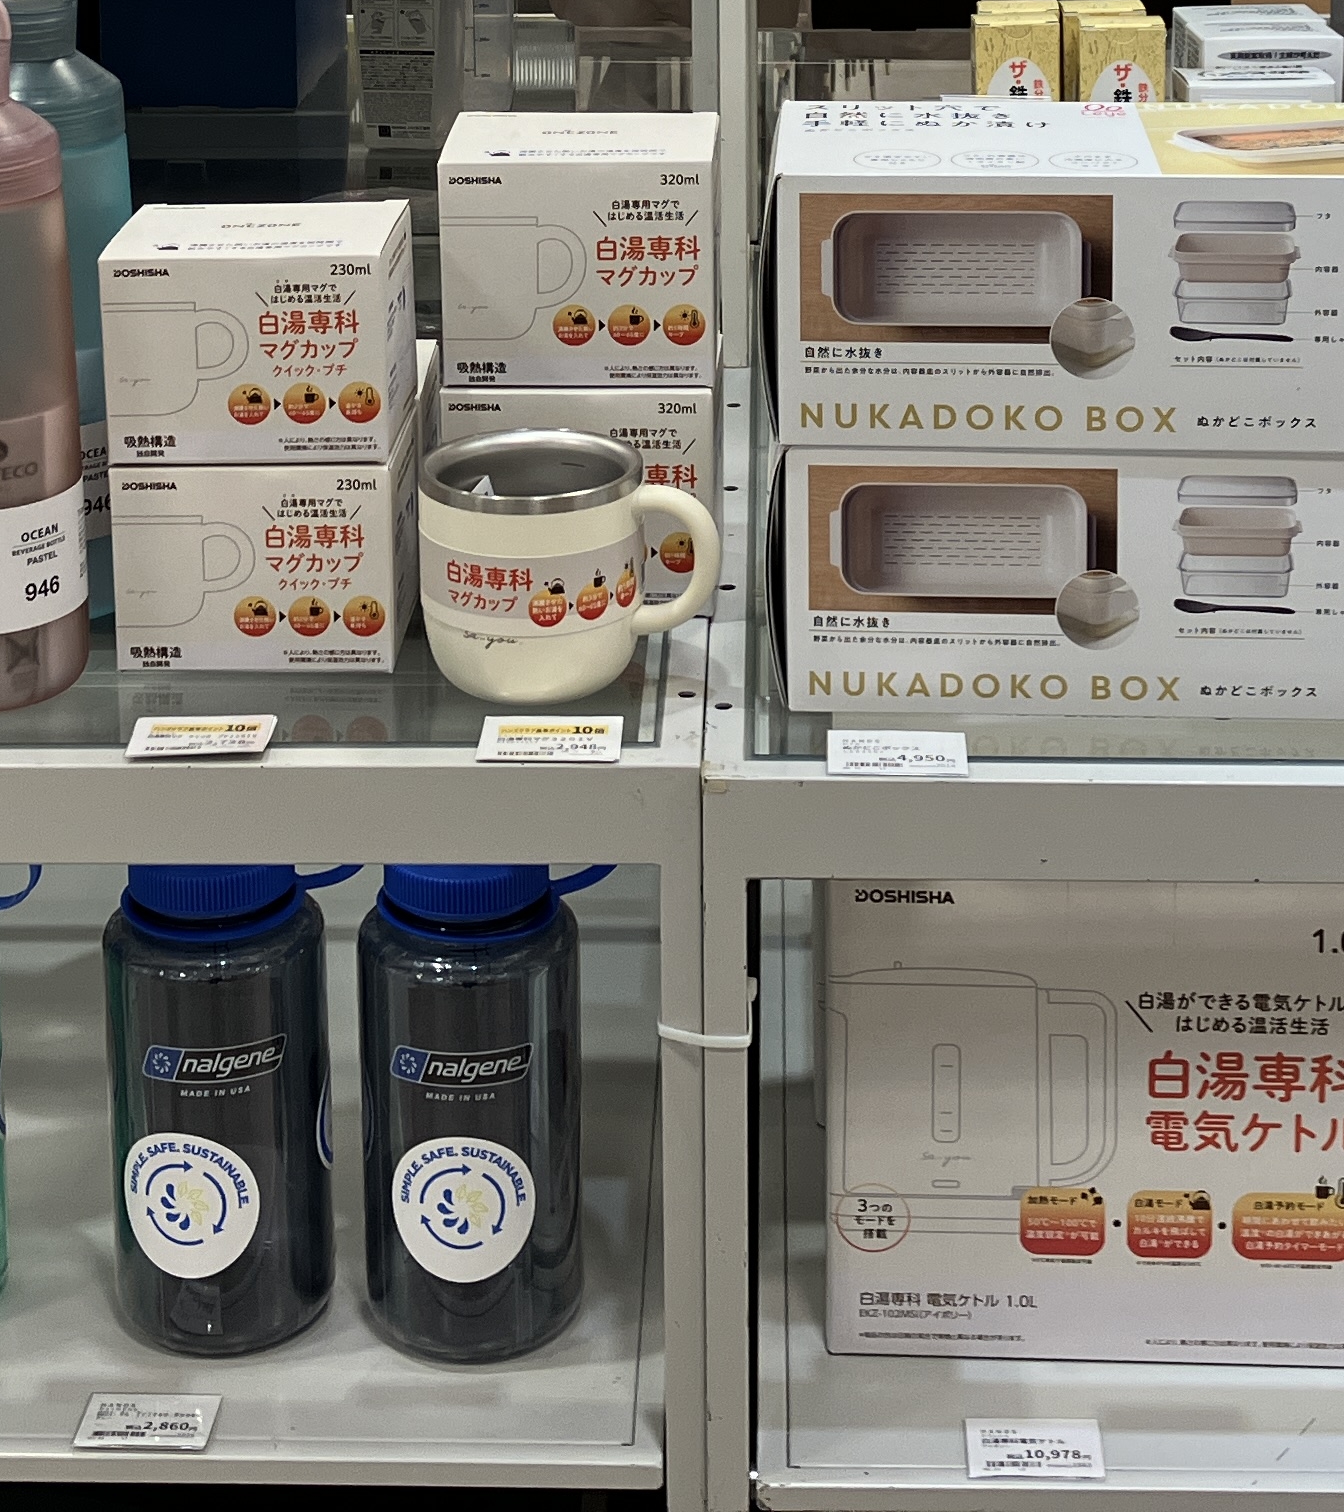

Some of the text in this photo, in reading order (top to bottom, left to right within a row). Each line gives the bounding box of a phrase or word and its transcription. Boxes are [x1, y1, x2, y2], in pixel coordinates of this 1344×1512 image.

[660, 173, 700, 186] 320ml
[596, 235, 700, 262] 白湯専科
[113, 269, 169, 277] DOSHISHA
[330, 263, 372, 276] 230ml
[596, 265, 699, 287] マグカップ
[258, 310, 359, 335] 白湯専科
[260, 338, 359, 360] マグカップ
[805, 346, 883, 359] 自然に水抜き
[273, 364, 347, 377] クイック・プチ
[657, 402, 697, 415] 320ml
[801, 403, 1177, 433] NUKADOKO BOX
[1197, 415, 1317, 429] ぬかどこボックス
[21, 523, 59, 543] OCEAN
[265, 524, 364, 549] 白湯専科
[26, 551, 59, 567] PASTEL
[447, 560, 533, 592] 白湯専科
[25, 574, 61, 602] 946
[448, 588, 518, 613] マグカップ
[808, 671, 1180, 702] NUKADOKO BOX
[1200, 685, 1317, 698] ぬかどこボックス
[855, 888, 955, 905] DOSHISHA
[1175, 1015, 1329, 1036] はじめる温活生活
[180, 1045, 282, 1078] nalgene
[428, 1054, 527, 1079] nalgene
[180, 1085, 251, 1098] MADE IN USA
[426, 1092, 455, 1101] MADE
[475, 1093, 496, 1101] USA
[400, 1146, 527, 1207] SIMPLE. SAFE. SUSTAINABLE.
[857, 1198, 893, 1214] 3つの
[859, 1292, 1038, 1309] 白湯専科 電気ケトル 1.0L
